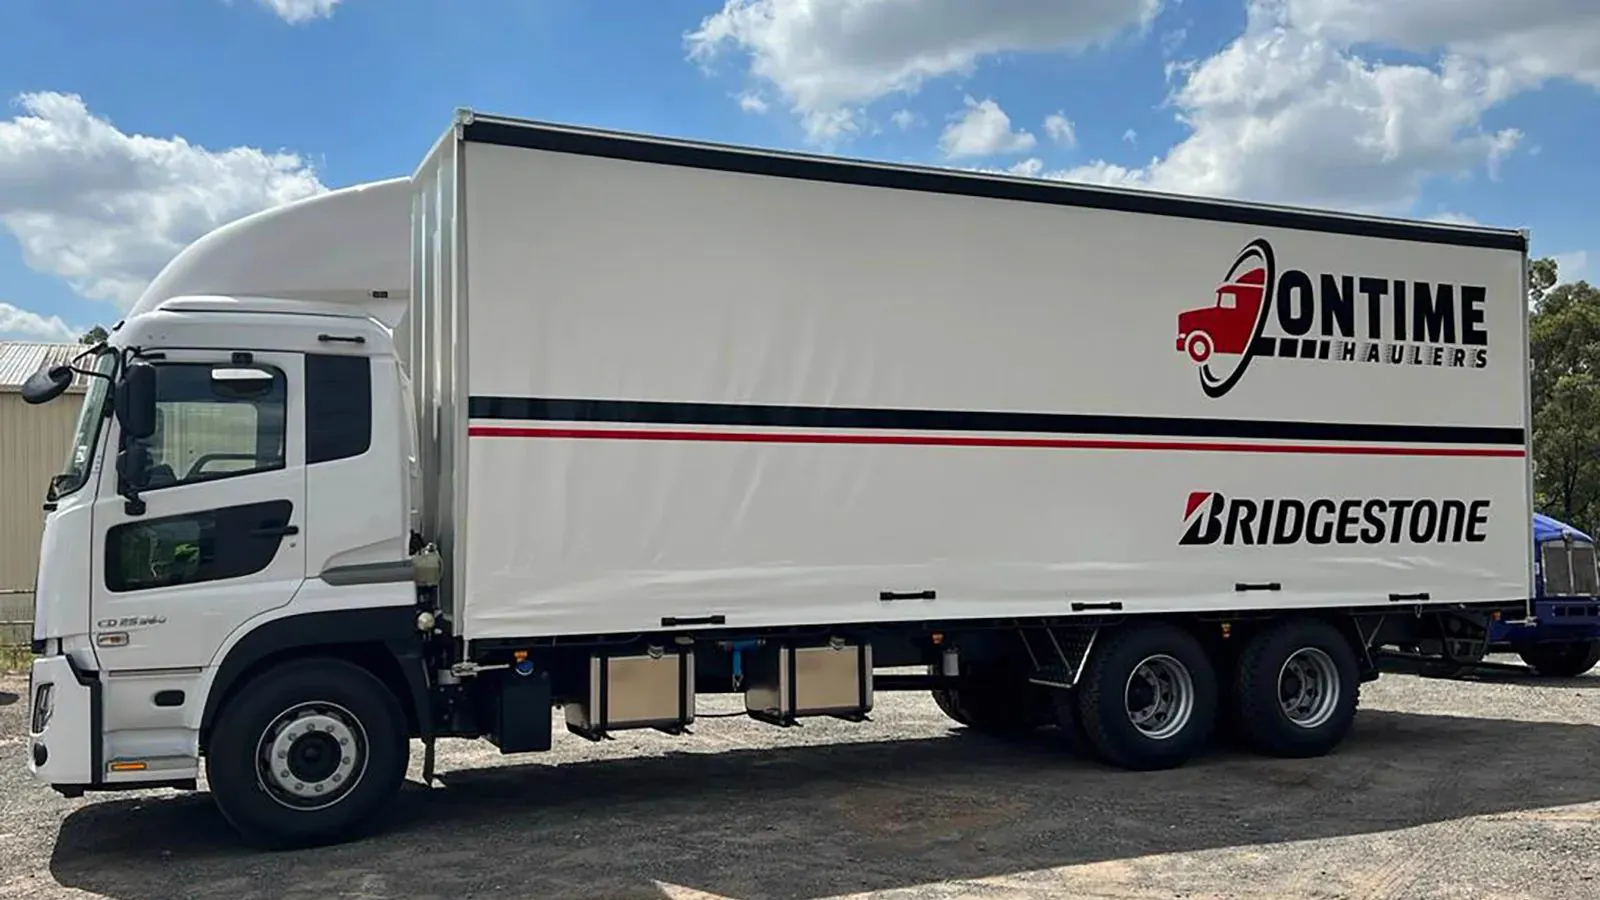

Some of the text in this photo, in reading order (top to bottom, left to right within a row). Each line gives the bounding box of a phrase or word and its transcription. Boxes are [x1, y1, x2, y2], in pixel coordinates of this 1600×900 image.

[1276, 269, 1489, 347] ONTIME
[1335, 340, 1488, 369] HAULERS
[1179, 491, 1490, 545] BRIDGESTONE
